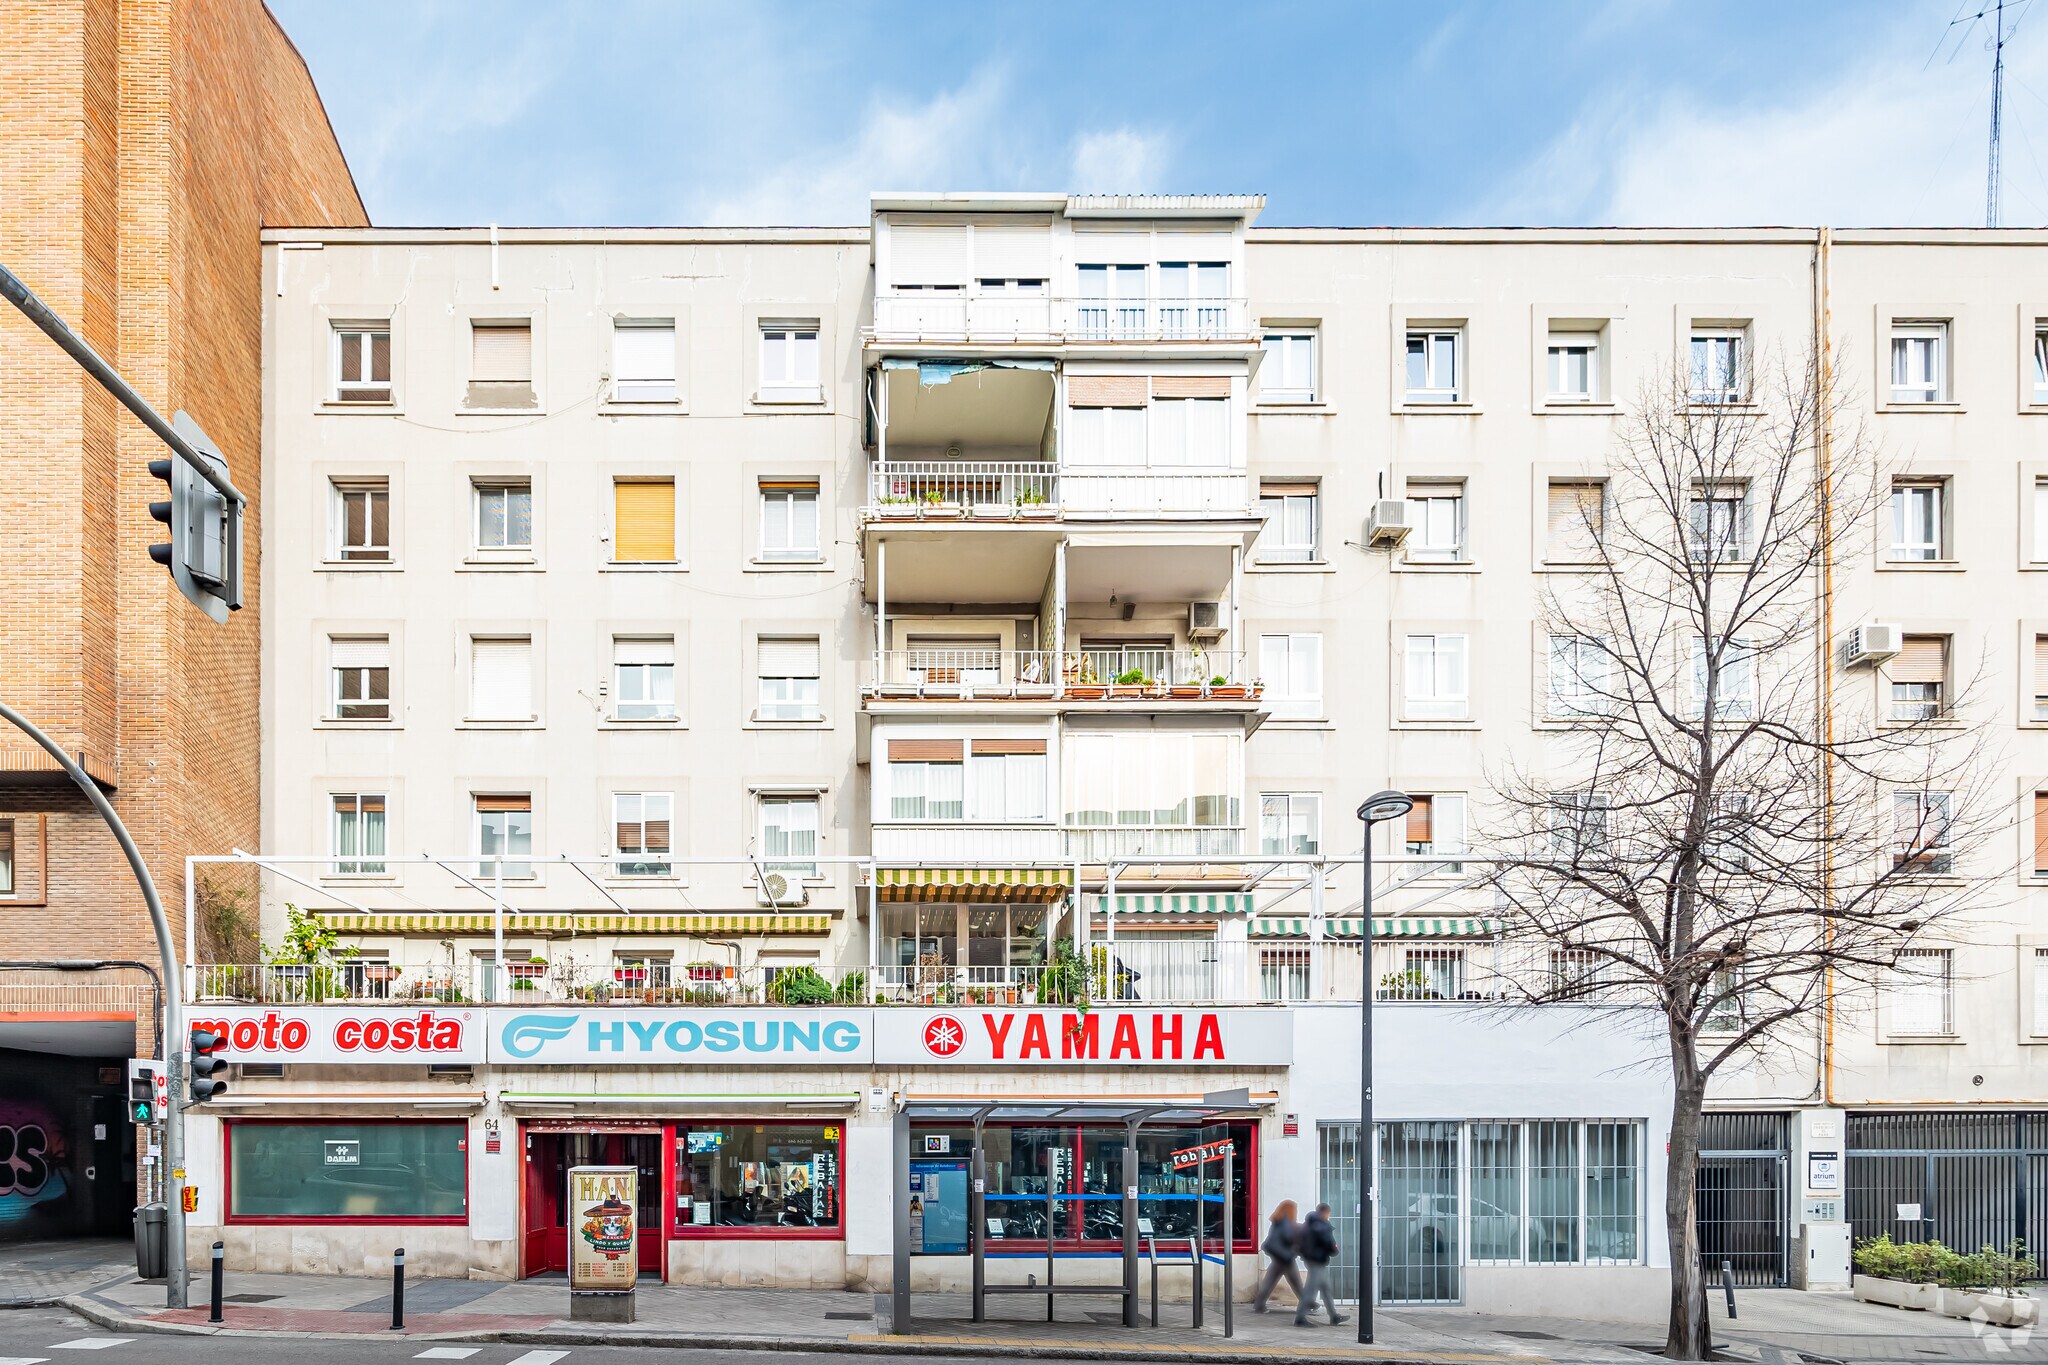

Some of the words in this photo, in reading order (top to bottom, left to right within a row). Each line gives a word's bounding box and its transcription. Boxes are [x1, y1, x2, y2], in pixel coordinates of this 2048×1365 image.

[333, 1011, 463, 1052] costa
[588, 1020, 861, 1052] HYOSUNG
[982, 1013, 1226, 1060] YAMAHA
[485, 1118, 499, 1130] 64
[817, 1154, 826, 1217] REBAJAS
